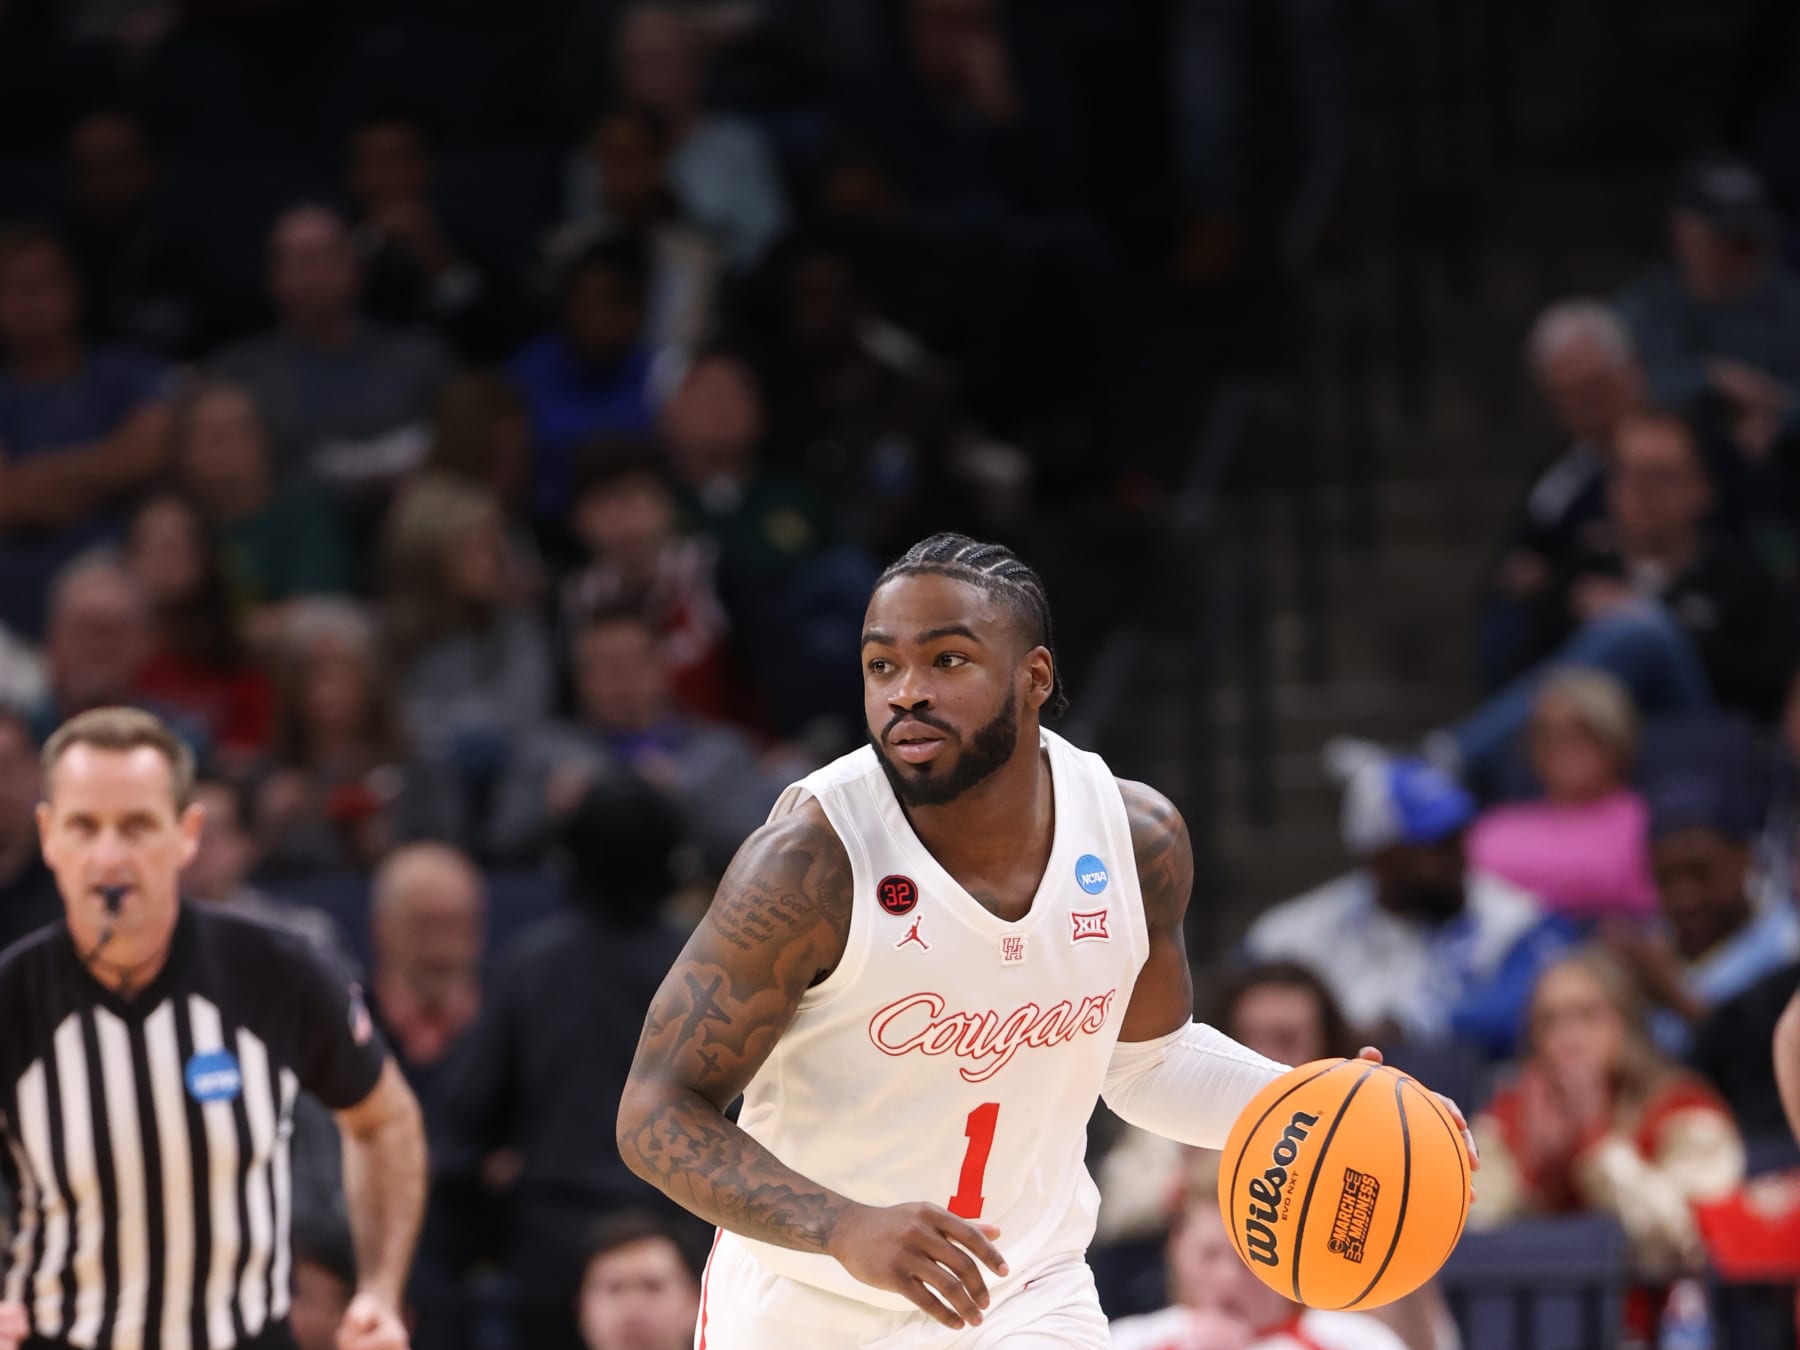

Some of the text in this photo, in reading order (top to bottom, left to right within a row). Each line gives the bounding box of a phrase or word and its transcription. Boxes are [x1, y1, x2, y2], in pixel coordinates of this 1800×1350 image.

[884, 882, 911, 907] 32
[1081, 871, 1107, 885] NCAA
[1003, 937, 1023, 961] UH
[1078, 918, 1101, 933] XII
[869, 989, 1116, 1083] Cougars
[947, 1102, 1000, 1218] 1
[1245, 1111, 1320, 1267] Wilson
[1282, 1170, 1299, 1221] EVO NXT
[1348, 1175, 1376, 1240] MADNESS
[1333, 1193, 1357, 1242] MARCH
